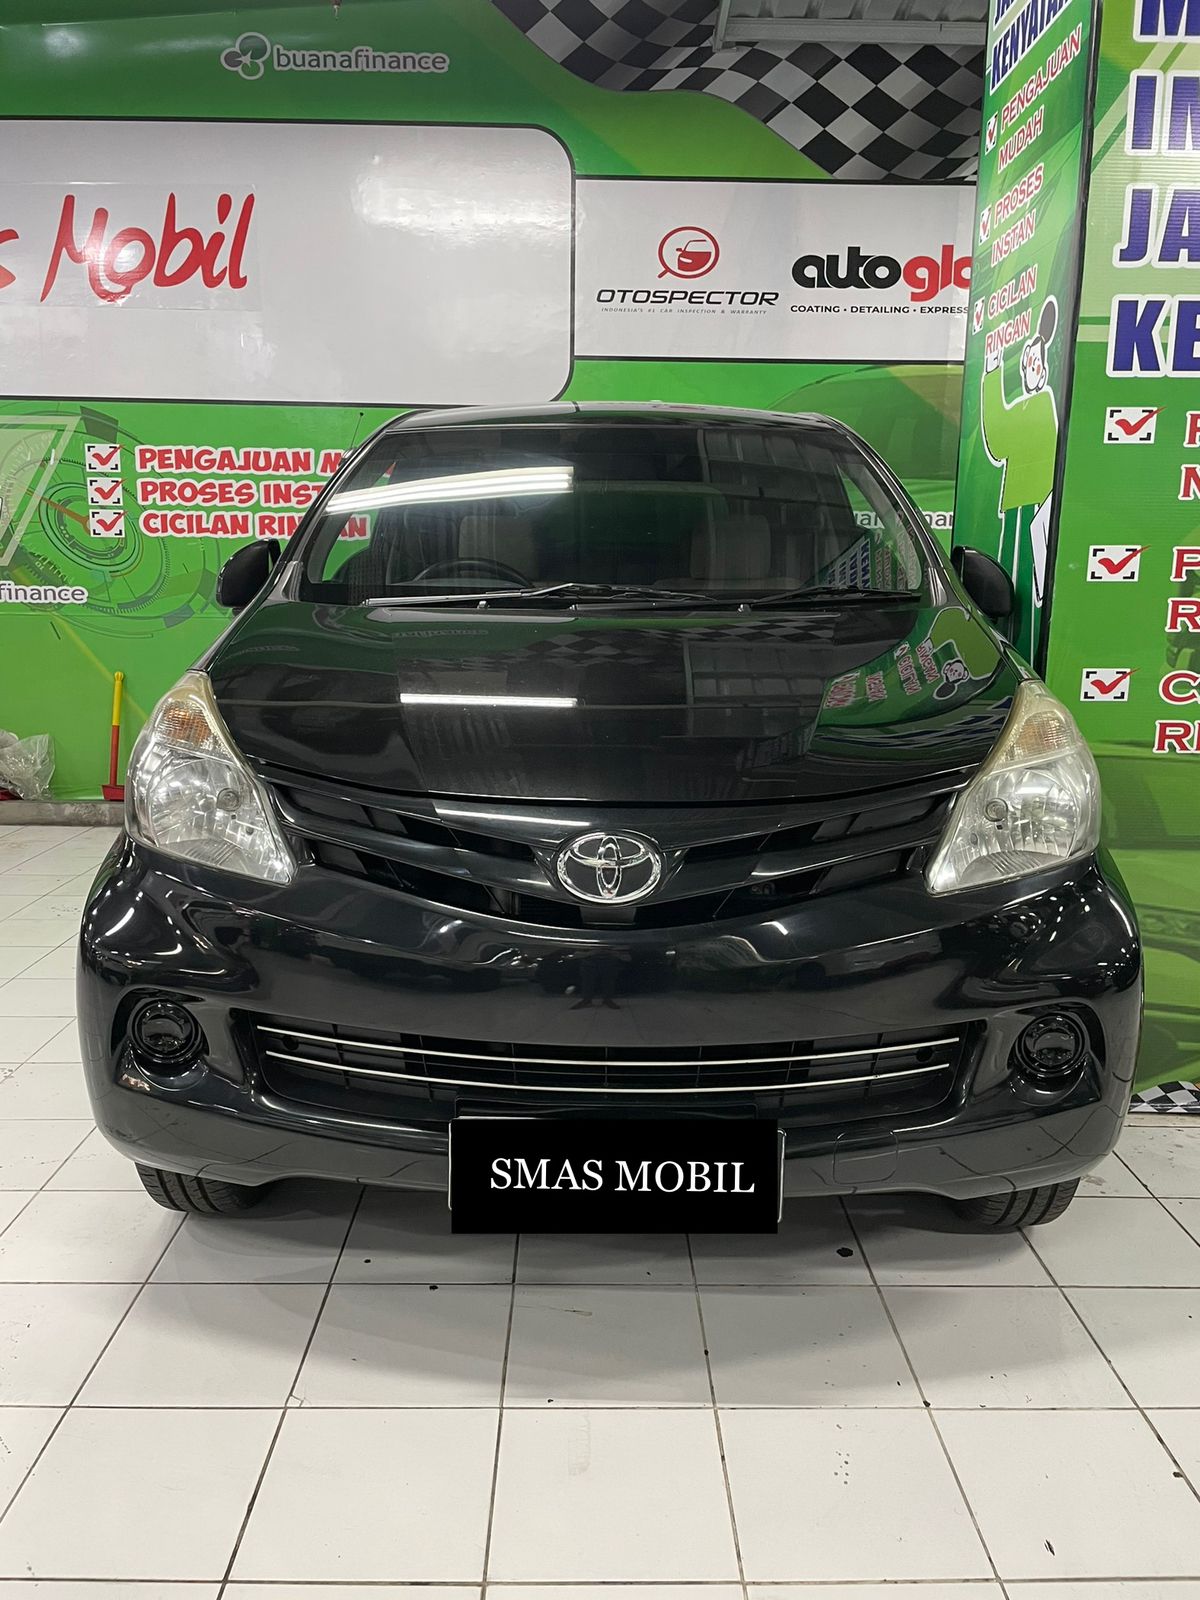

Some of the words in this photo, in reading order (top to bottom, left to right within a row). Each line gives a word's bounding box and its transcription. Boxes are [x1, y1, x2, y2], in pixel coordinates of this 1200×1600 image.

[276, 48, 447, 71] buanafinance
[1001, 27, 1081, 131] PENGAJUAN
[999, 108, 1043, 169] MUDAH
[994, 166, 1043, 225] PROSES
[41, 192, 255, 302] Mobil
[992, 213, 1034, 264] INSTAN
[597, 289, 779, 306] OTOSPECTOR
[791, 305, 840, 313] COATING
[851, 305, 910, 314] DETAILING
[988, 268, 1036, 316] CICILAN
[986, 315, 1031, 354] RINGAN
[139, 448, 310, 472] PENGAJUAN
[140, 482, 254, 504] PROSES
[143, 513, 249, 536] CICILAN
